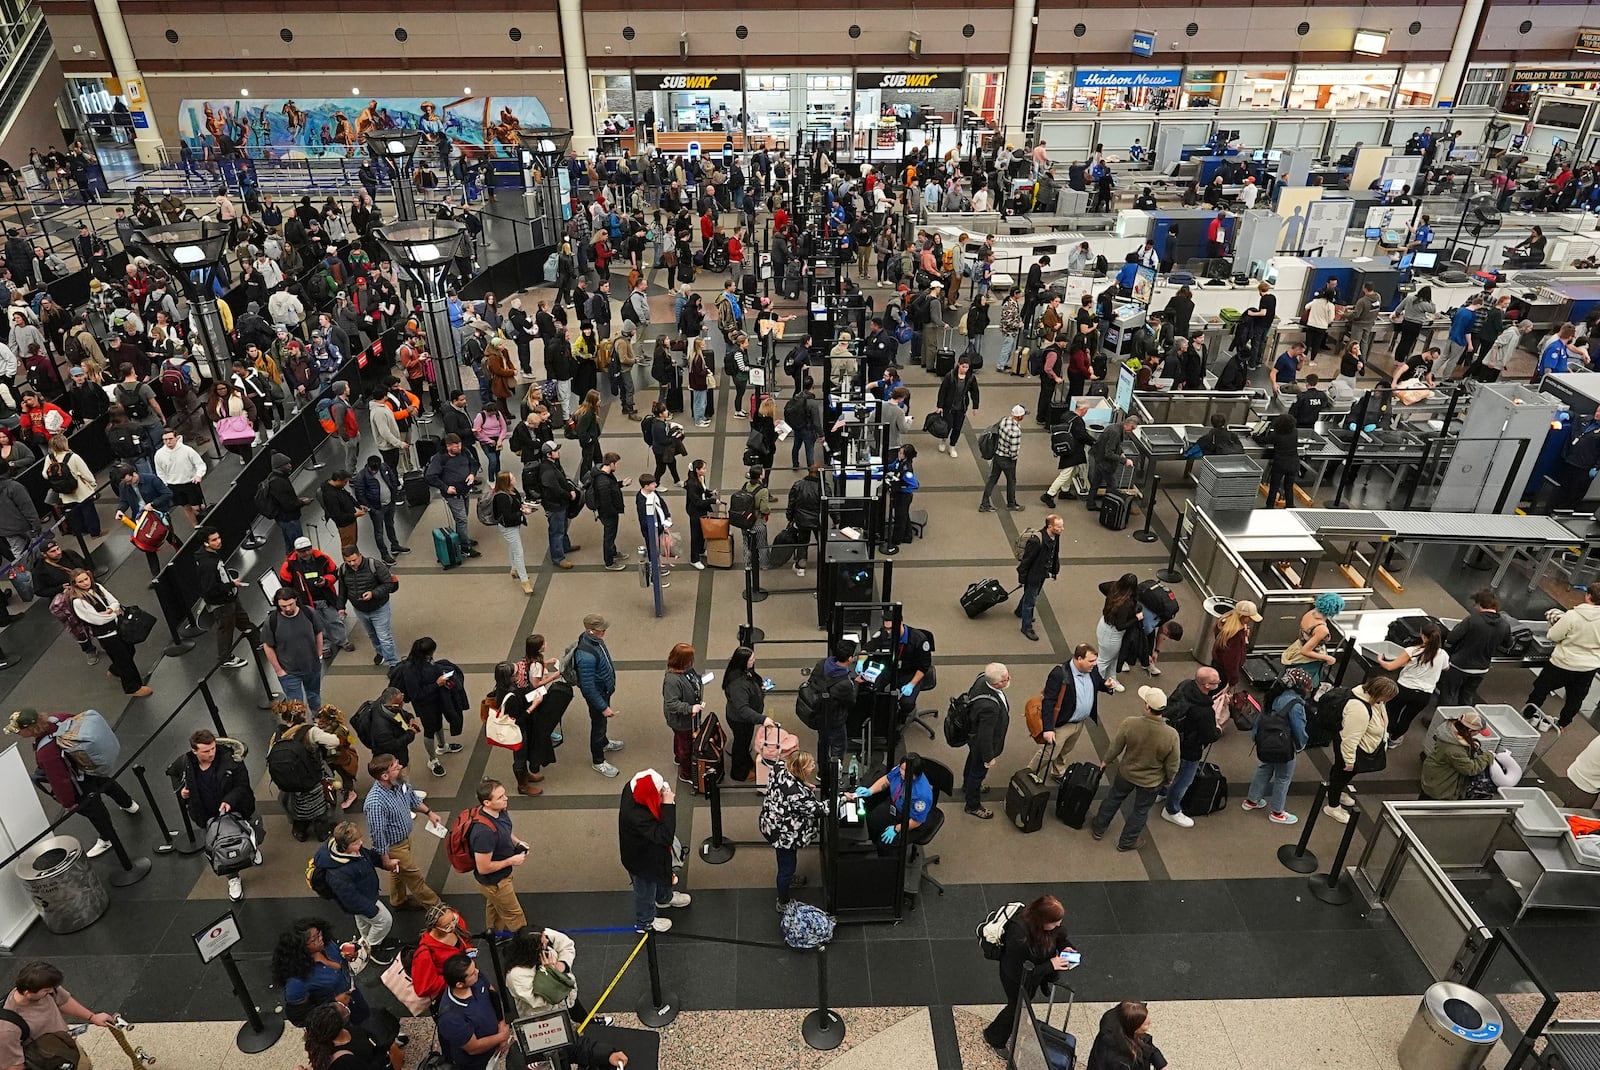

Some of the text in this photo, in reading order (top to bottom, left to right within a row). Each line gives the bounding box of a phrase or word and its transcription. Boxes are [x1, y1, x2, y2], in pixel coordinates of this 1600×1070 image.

[879, 74, 938, 87] SUBWAY
[1083, 73, 1172, 85] Hudson News
[1516, 71, 1547, 80] BOULDER
[1549, 71, 1567, 80] BEER
[1571, 71, 1584, 79] TAP
[659, 75, 718, 89] SUBWAY
[1309, 398, 1322, 406] TSA
[528, 1027, 562, 1039] ISSUES
